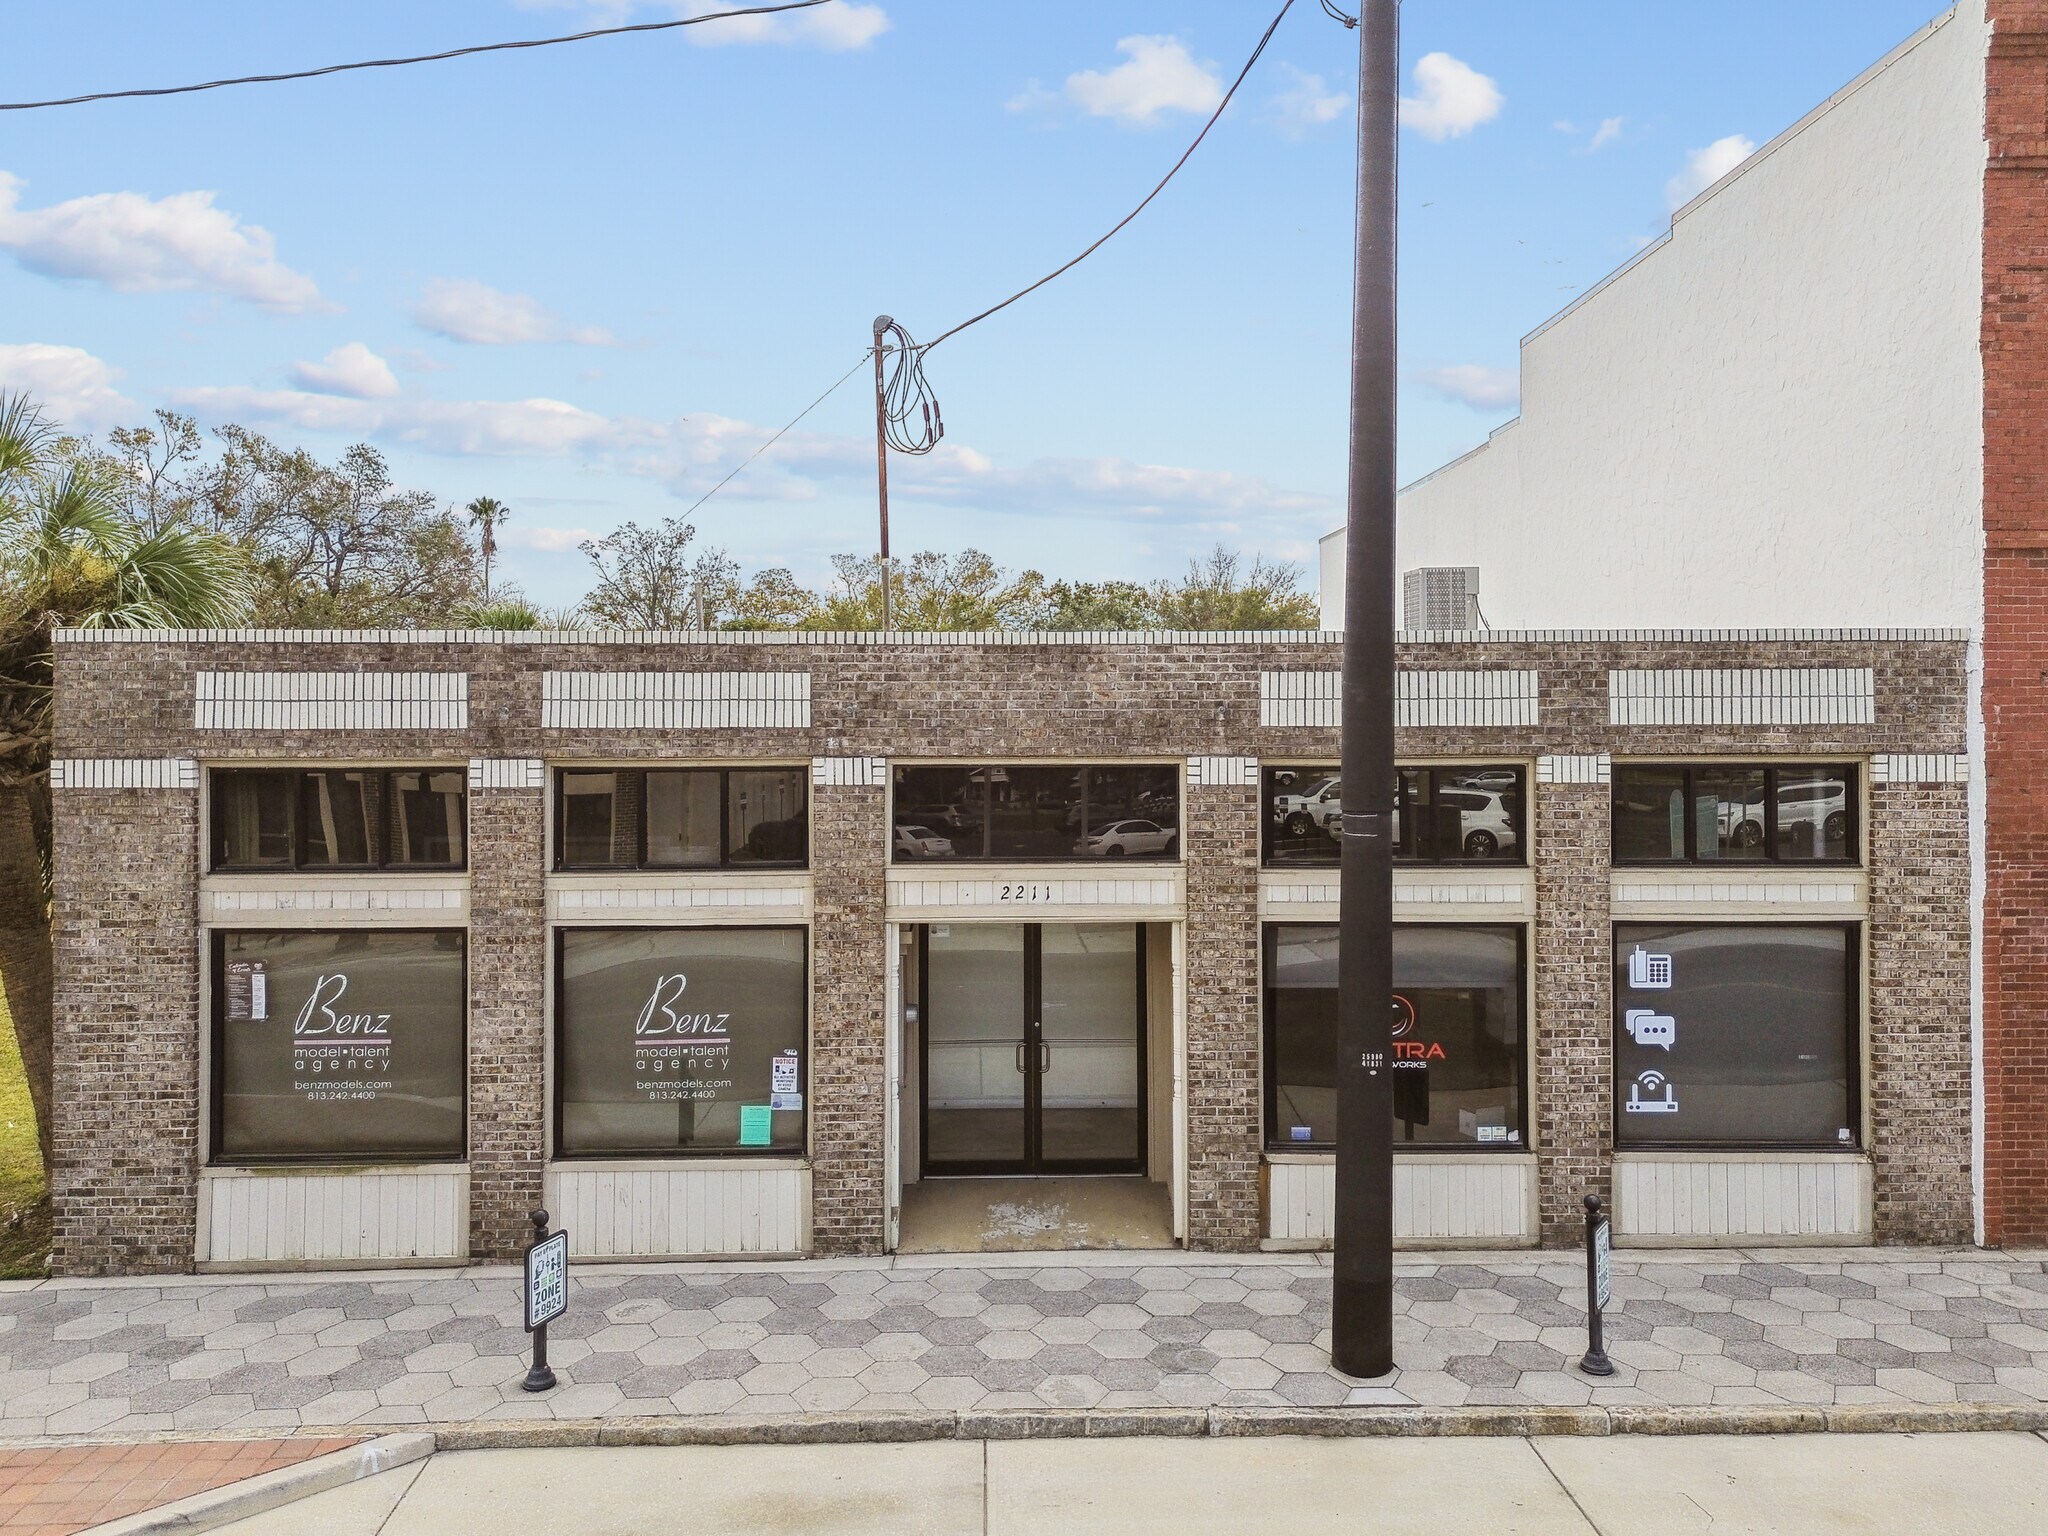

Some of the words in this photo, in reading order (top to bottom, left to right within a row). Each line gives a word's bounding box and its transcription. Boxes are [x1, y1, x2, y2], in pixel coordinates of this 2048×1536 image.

[1000, 885, 1050, 901] 2211
[294, 973, 391, 1035] Benz
[635, 973, 730, 1035] Benz
[294, 1046, 341, 1058] model
[350, 1045, 390, 1057] talent
[635, 1045, 681, 1058] model
[690, 1044, 729, 1056] talent
[1392, 1042, 1446, 1059] TRA
[294, 1058, 391, 1072] agency
[635, 1057, 730, 1072] agency
[294, 1080, 392, 1090] benzmodels.com
[636, 1078, 732, 1090] benzmodels.com
[307, 1091, 376, 1100] 813.242.4400
[649, 1090, 716, 1100] 813.242.4400
[535, 1281, 561, 1306] ZONE
[534, 1294, 562, 1319] #9924
